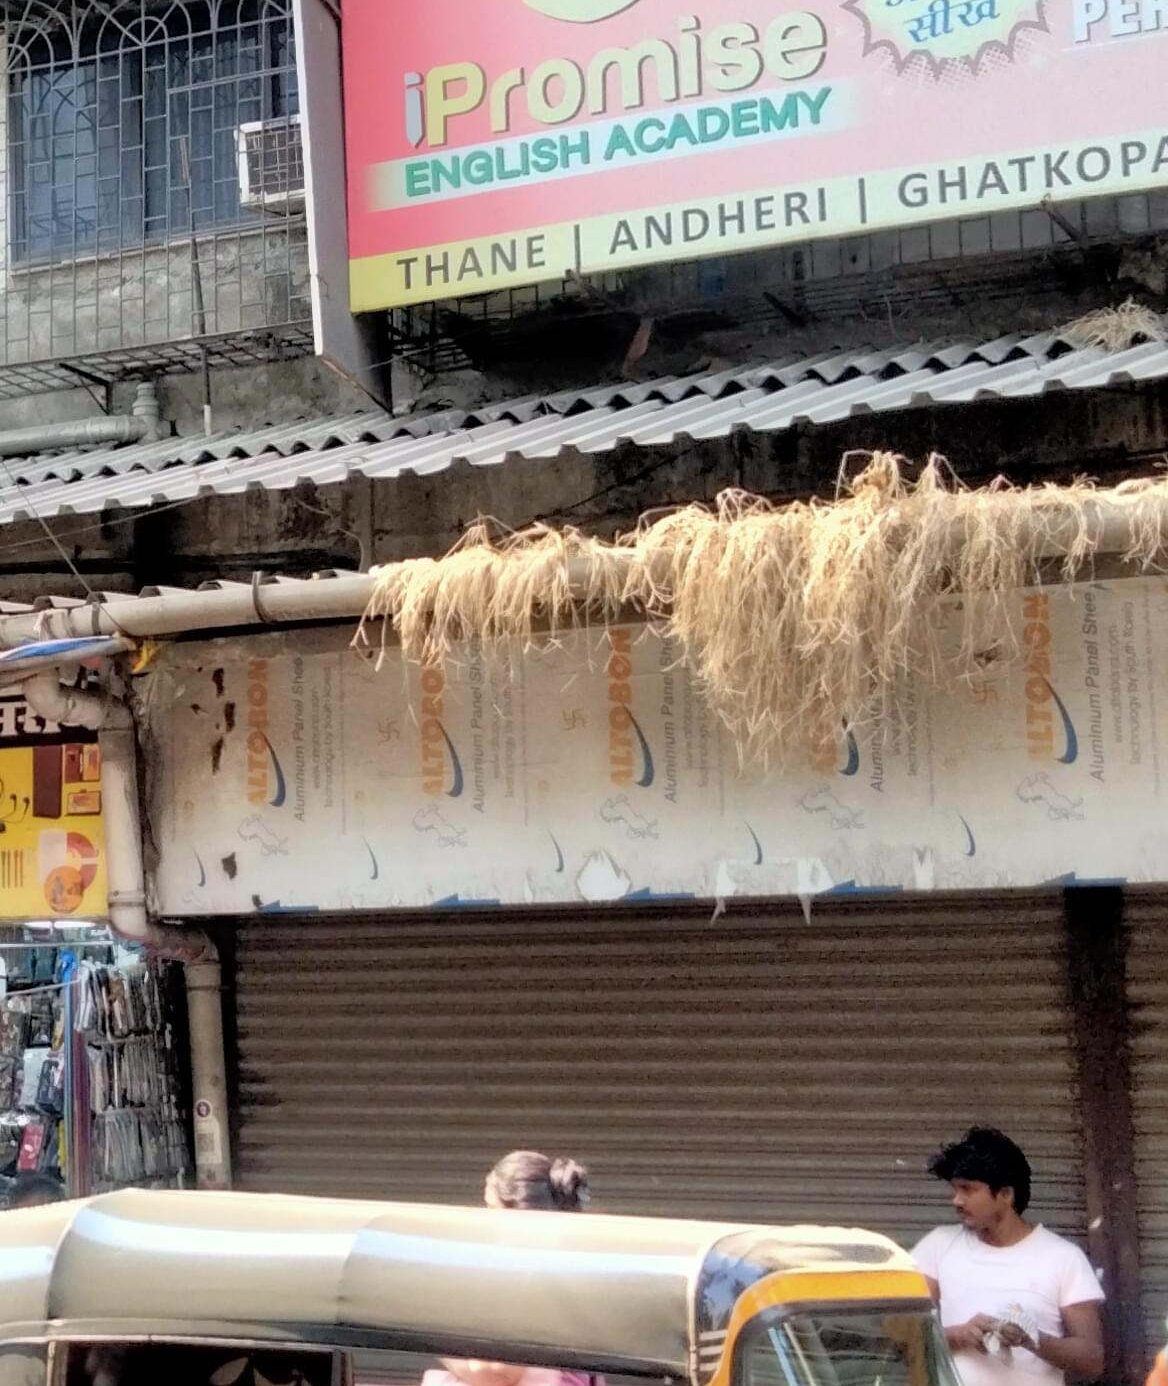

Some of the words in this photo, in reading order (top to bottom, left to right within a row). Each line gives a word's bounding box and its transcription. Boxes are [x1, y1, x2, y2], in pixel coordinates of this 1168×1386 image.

[403, 11, 829, 149] iPromise
[404, 129, 590, 198] ENGLISH
[603, 86, 833, 160] ACADEMY
[395, 232, 547, 292] THANE
[609, 186, 826, 255] ANDHERI
[1081, 640, 1099, 688] Panel
[292, 699, 305, 742] Panel
[420, 661, 445, 798] ALTOBO
[470, 687, 483, 729] Panel
[1087, 693, 1104, 782] Aluminium
[292, 746, 305, 822] Aluminium
[663, 721, 677, 804] Aluminium
